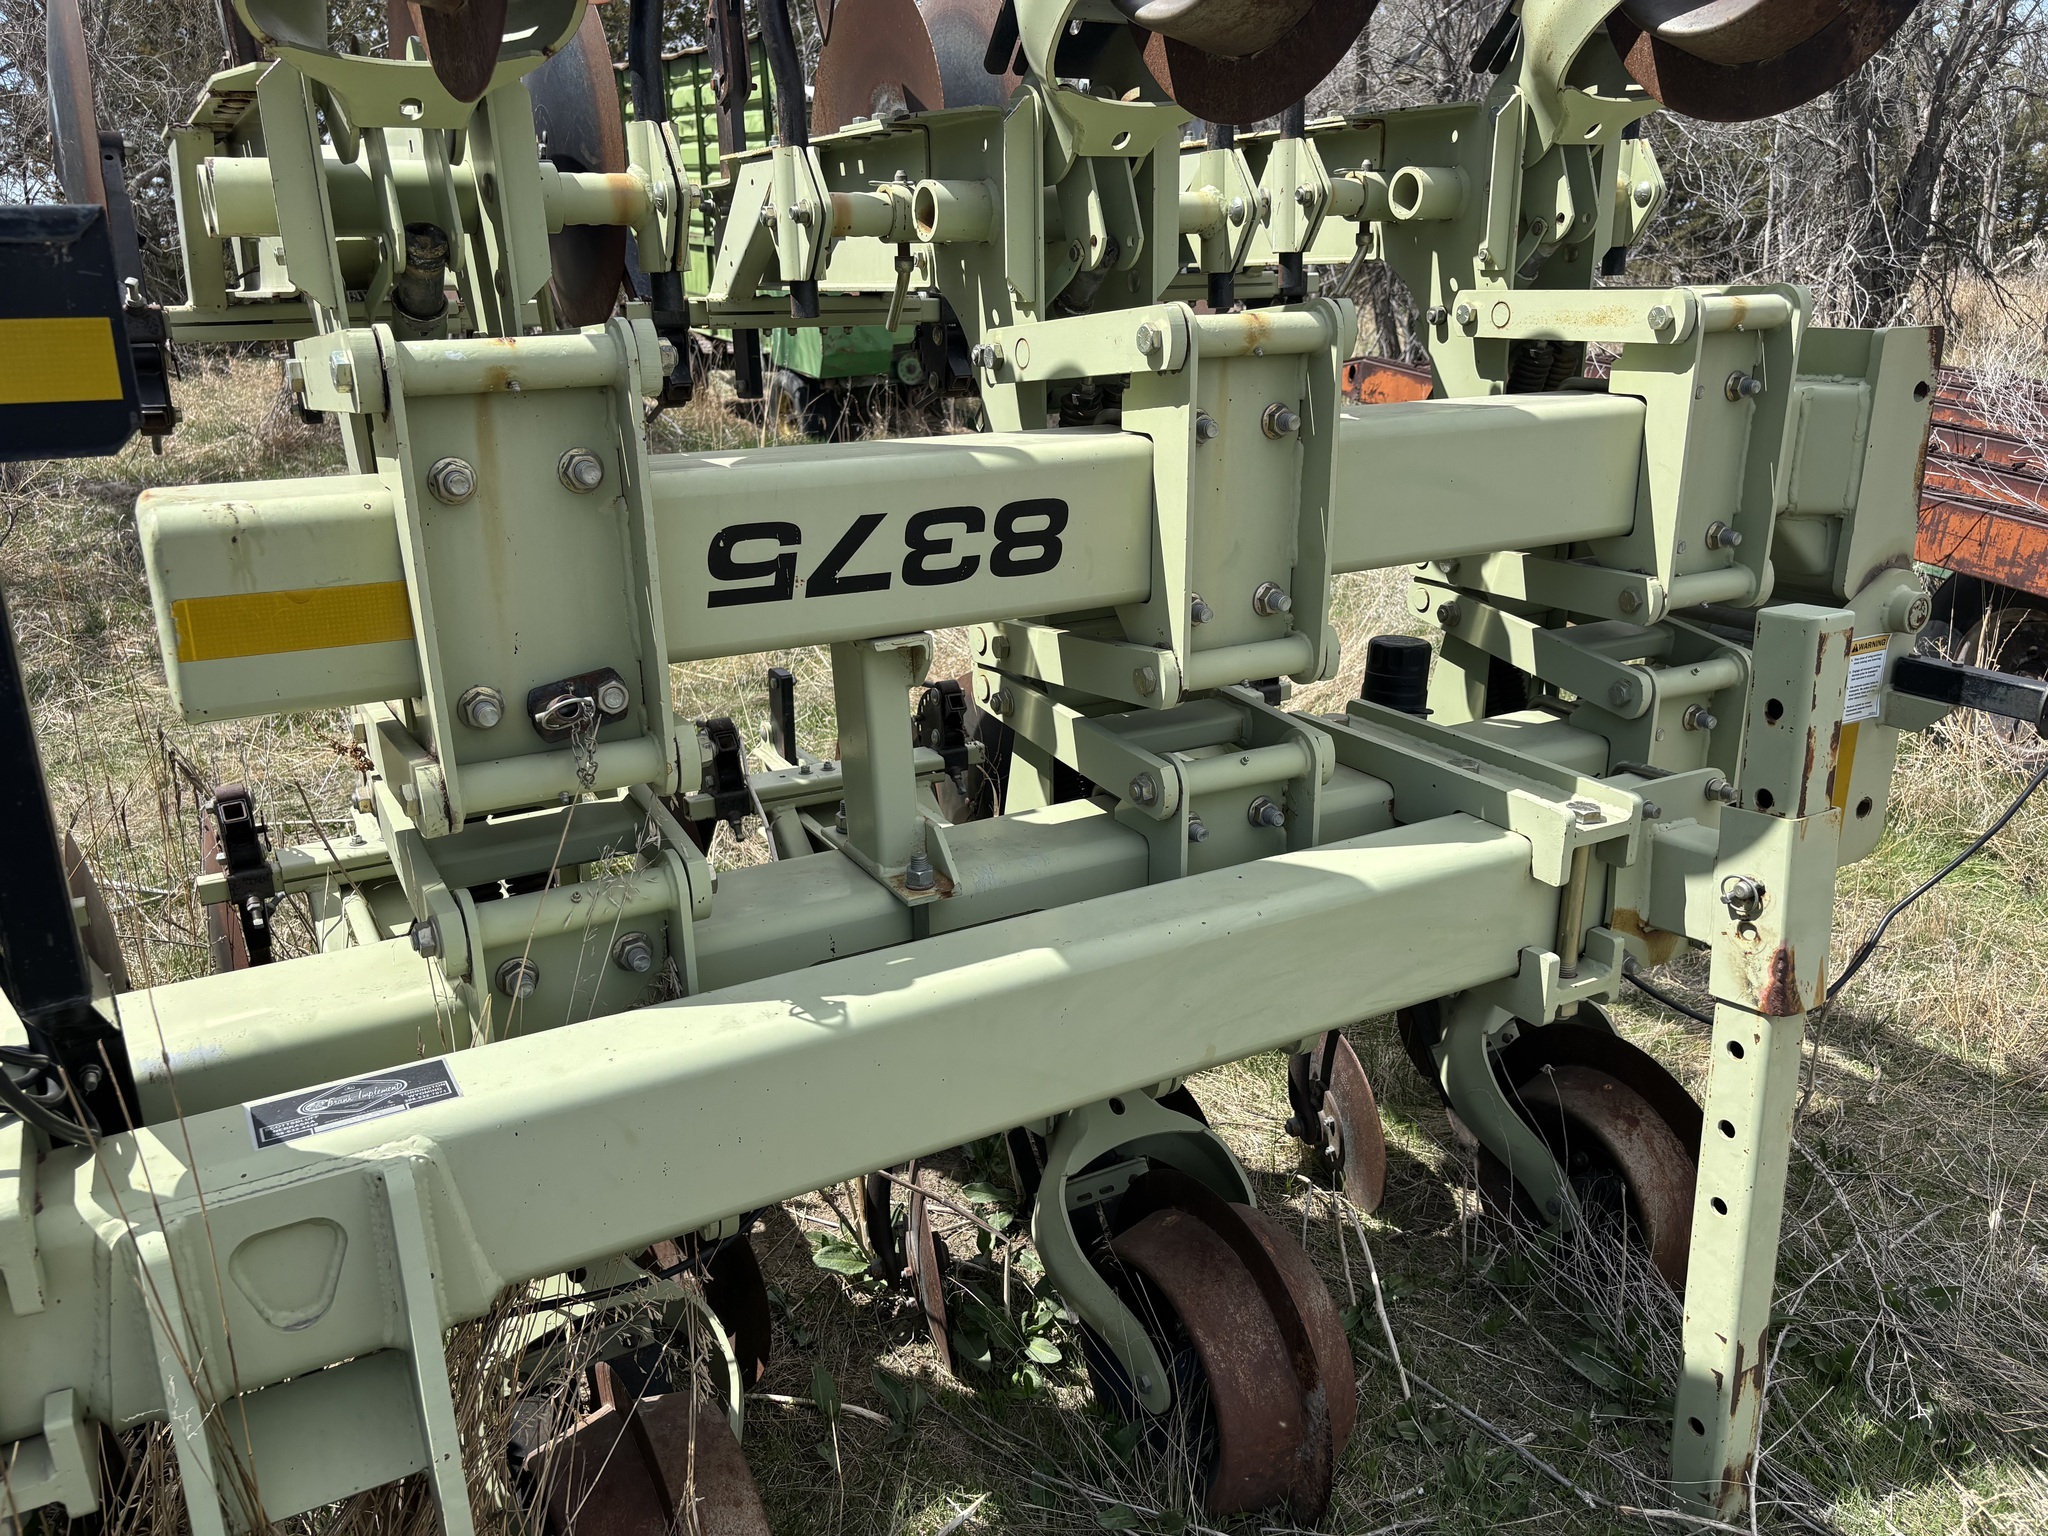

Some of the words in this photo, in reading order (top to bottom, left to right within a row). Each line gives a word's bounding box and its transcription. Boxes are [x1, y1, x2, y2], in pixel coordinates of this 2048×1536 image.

[707, 497, 1070, 608] 8375
[1858, 638, 1886, 650] WARNING
[357, 1082, 402, 1099] Implement
[401, 1082, 446, 1096] TORRINGTON
[408, 1087, 442, 1098] WYOMING
[272, 1120, 315, 1133] NEBRASKA
